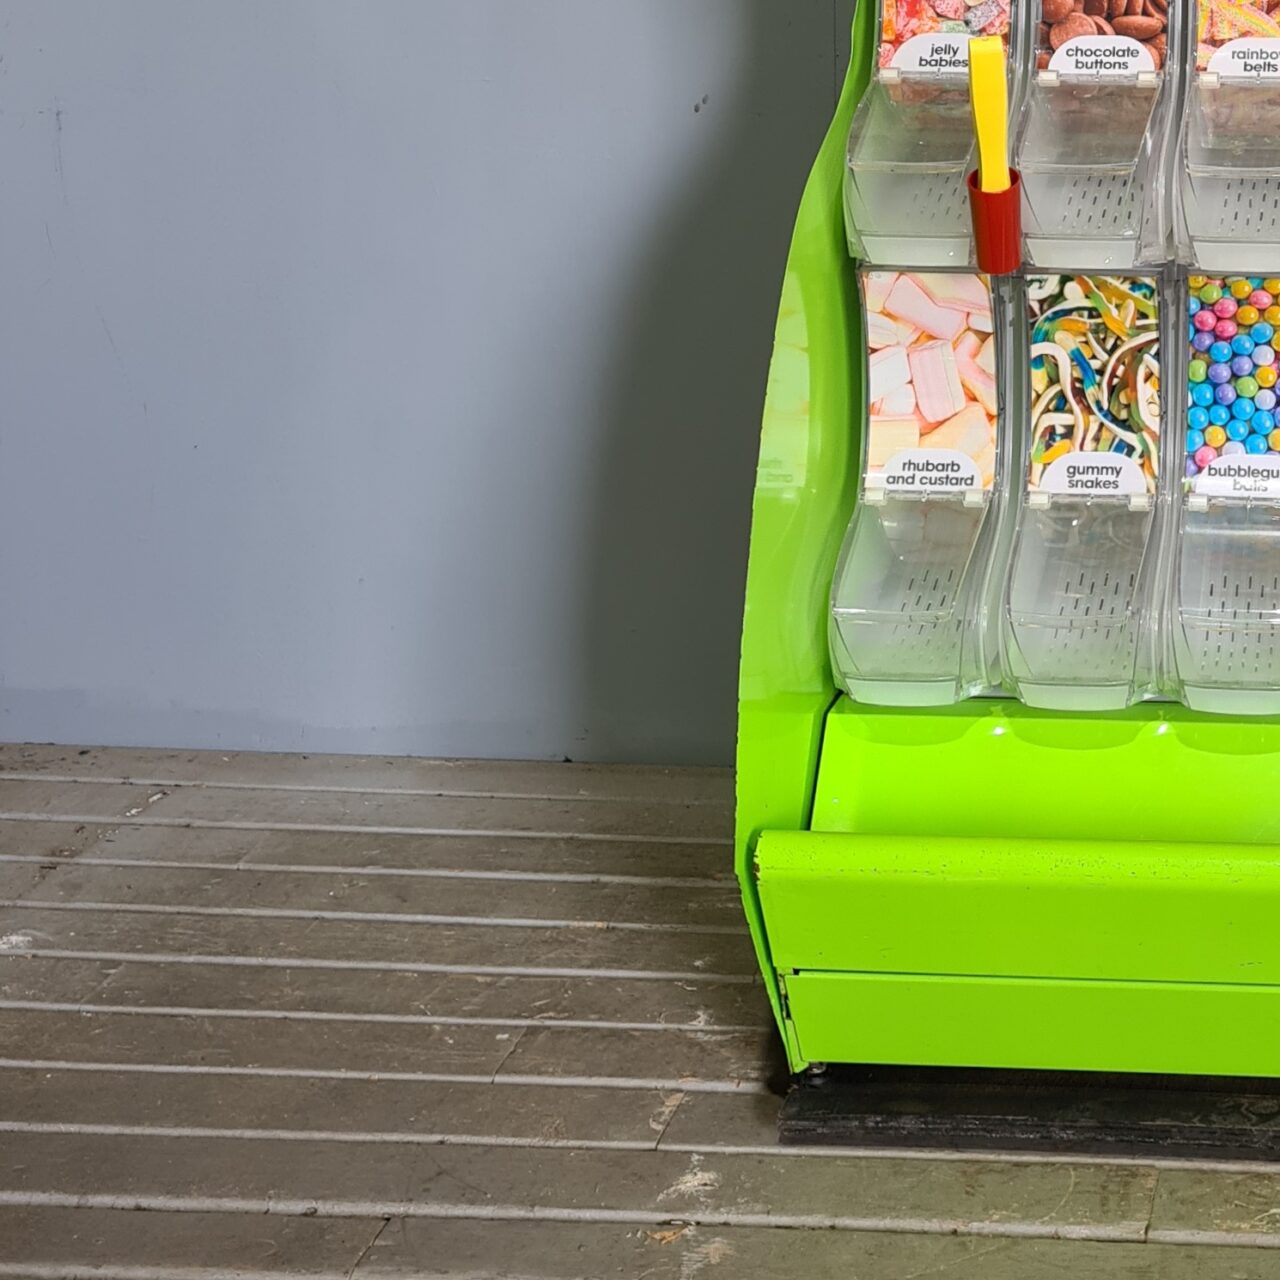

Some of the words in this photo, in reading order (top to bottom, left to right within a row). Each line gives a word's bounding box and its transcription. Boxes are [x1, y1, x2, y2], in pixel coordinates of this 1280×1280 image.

[930, 43, 960, 57] jelly
[1066, 45, 1140, 58] chocolate
[918, 56, 969, 67] babies
[1075, 58, 1129, 70] buttons
[1243, 61, 1278, 72] belts
[902, 460, 960, 472] rhubarb
[1066, 465, 1122, 479] gummy
[886, 473, 916, 485] and
[919, 474, 974, 487] custard
[1068, 477, 1119, 490] snakes
